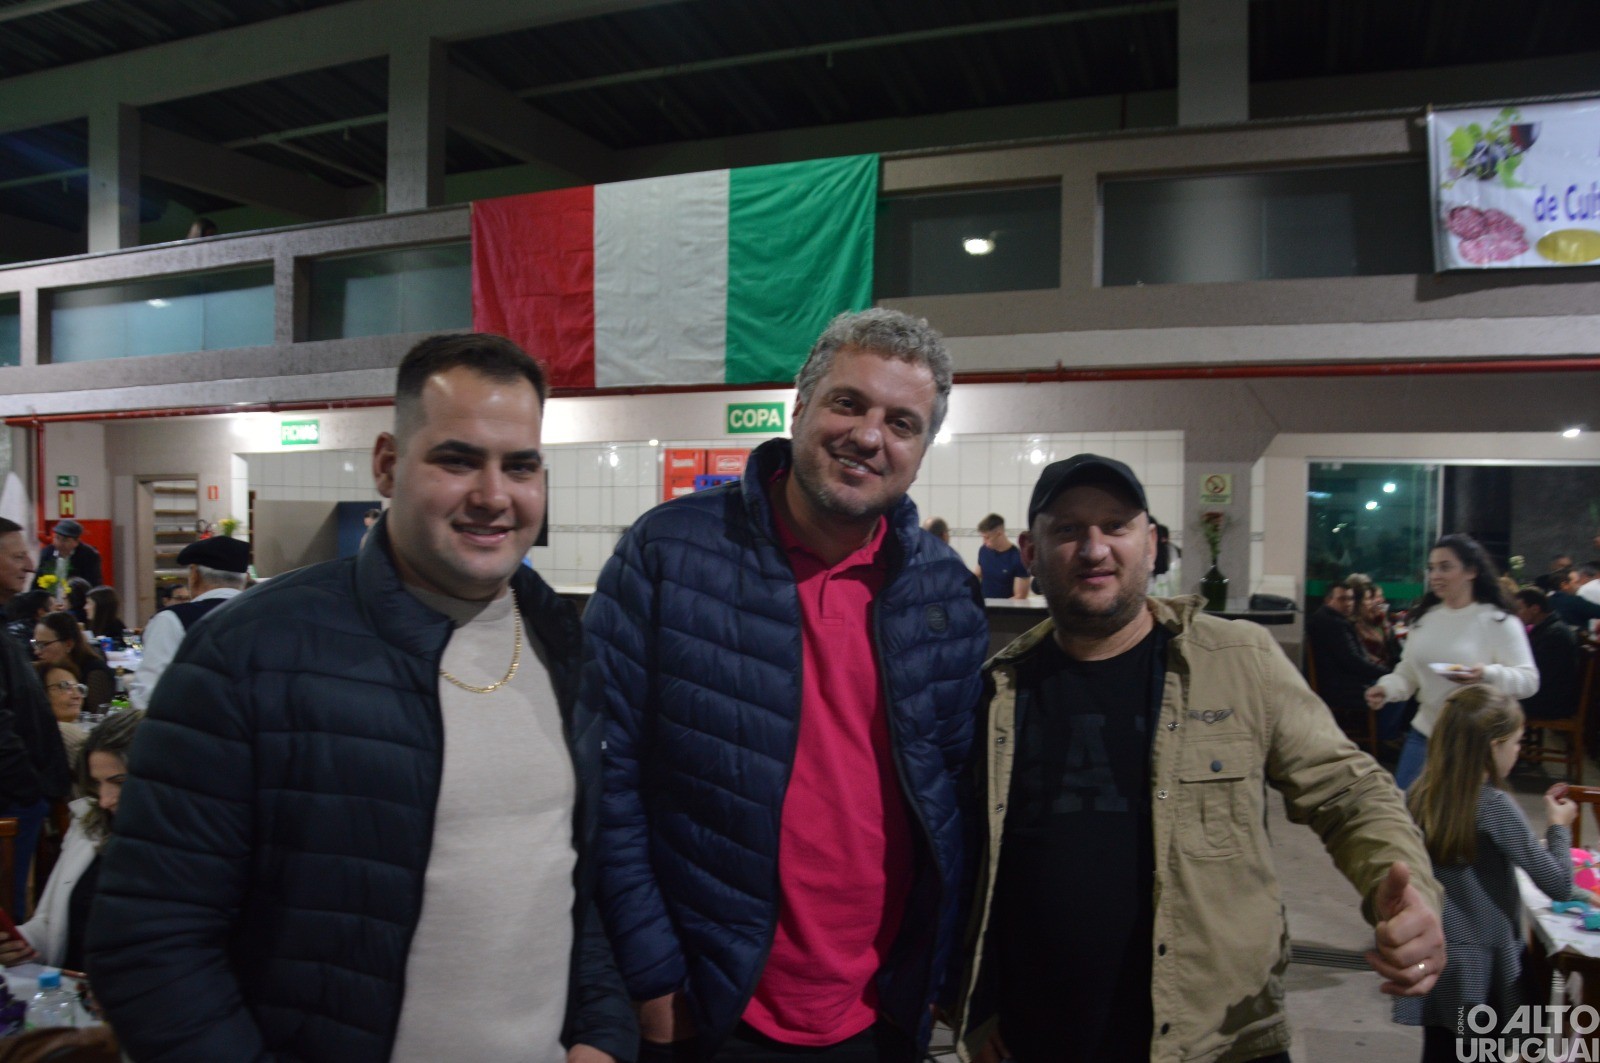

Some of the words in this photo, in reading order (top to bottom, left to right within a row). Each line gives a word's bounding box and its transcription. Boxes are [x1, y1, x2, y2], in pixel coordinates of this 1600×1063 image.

[1534, 185, 1558, 222] de
[729, 408, 782, 428] COPA
[60, 493, 74, 515] H
